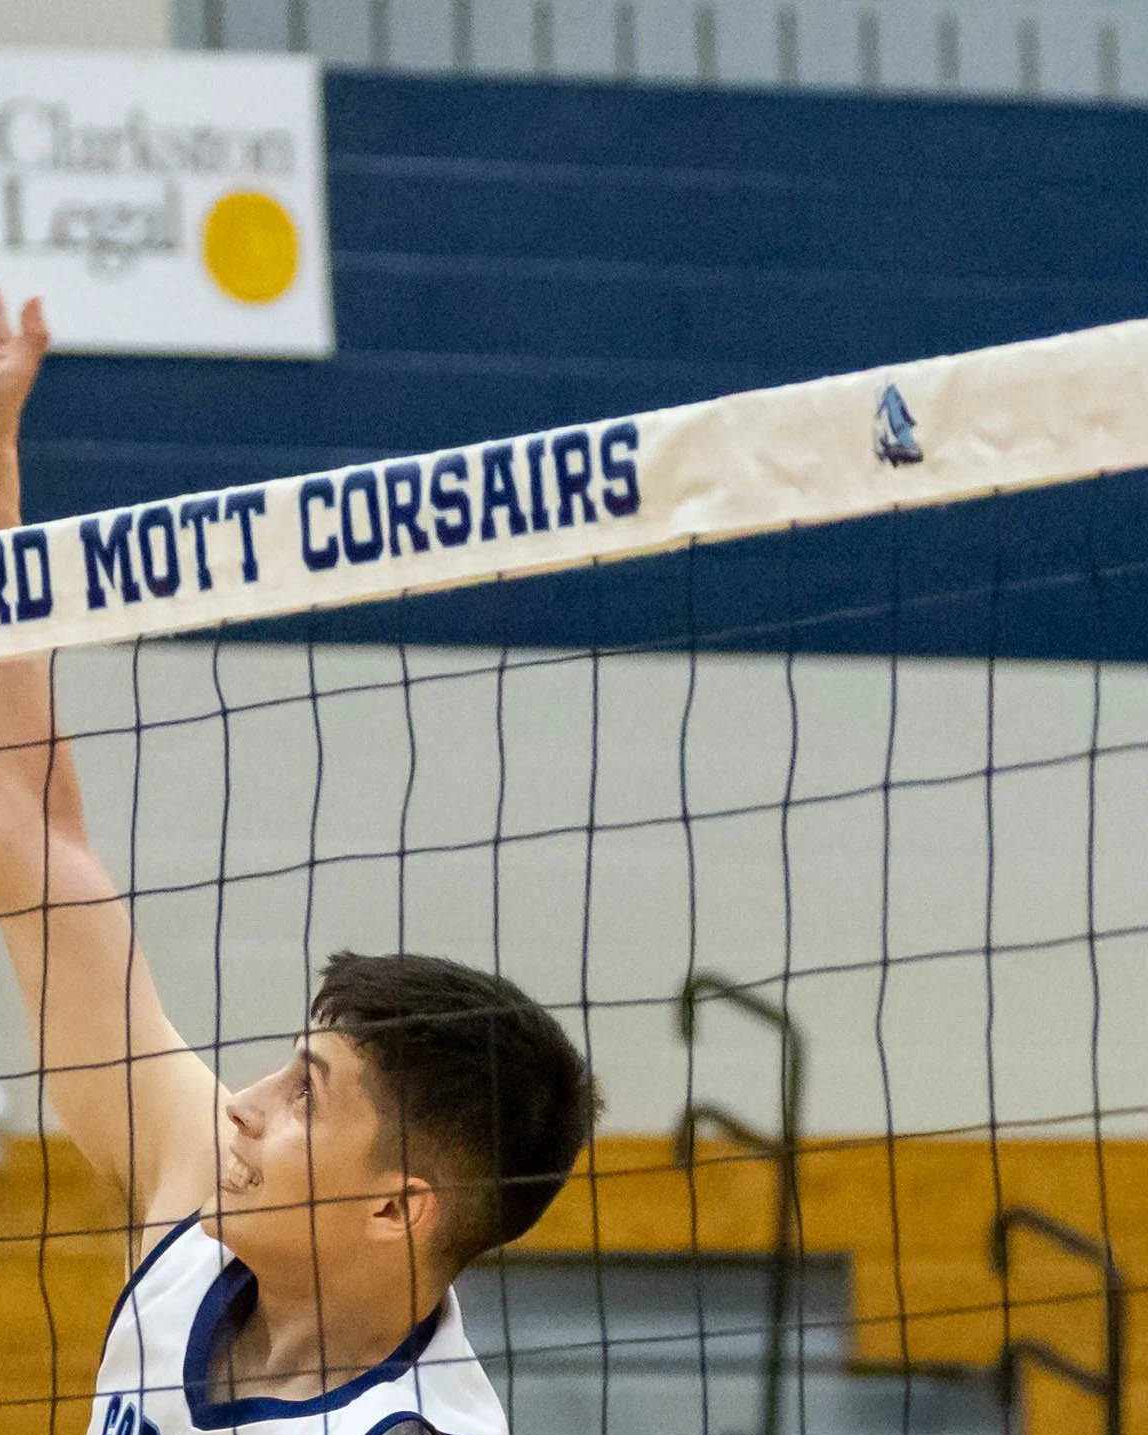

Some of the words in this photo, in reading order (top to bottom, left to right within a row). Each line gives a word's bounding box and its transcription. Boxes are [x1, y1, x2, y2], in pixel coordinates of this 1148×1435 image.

[2, 173, 184, 280] Legal
[79, 489, 266, 609] MOTT
[299, 421, 642, 572] CORSAIRS
